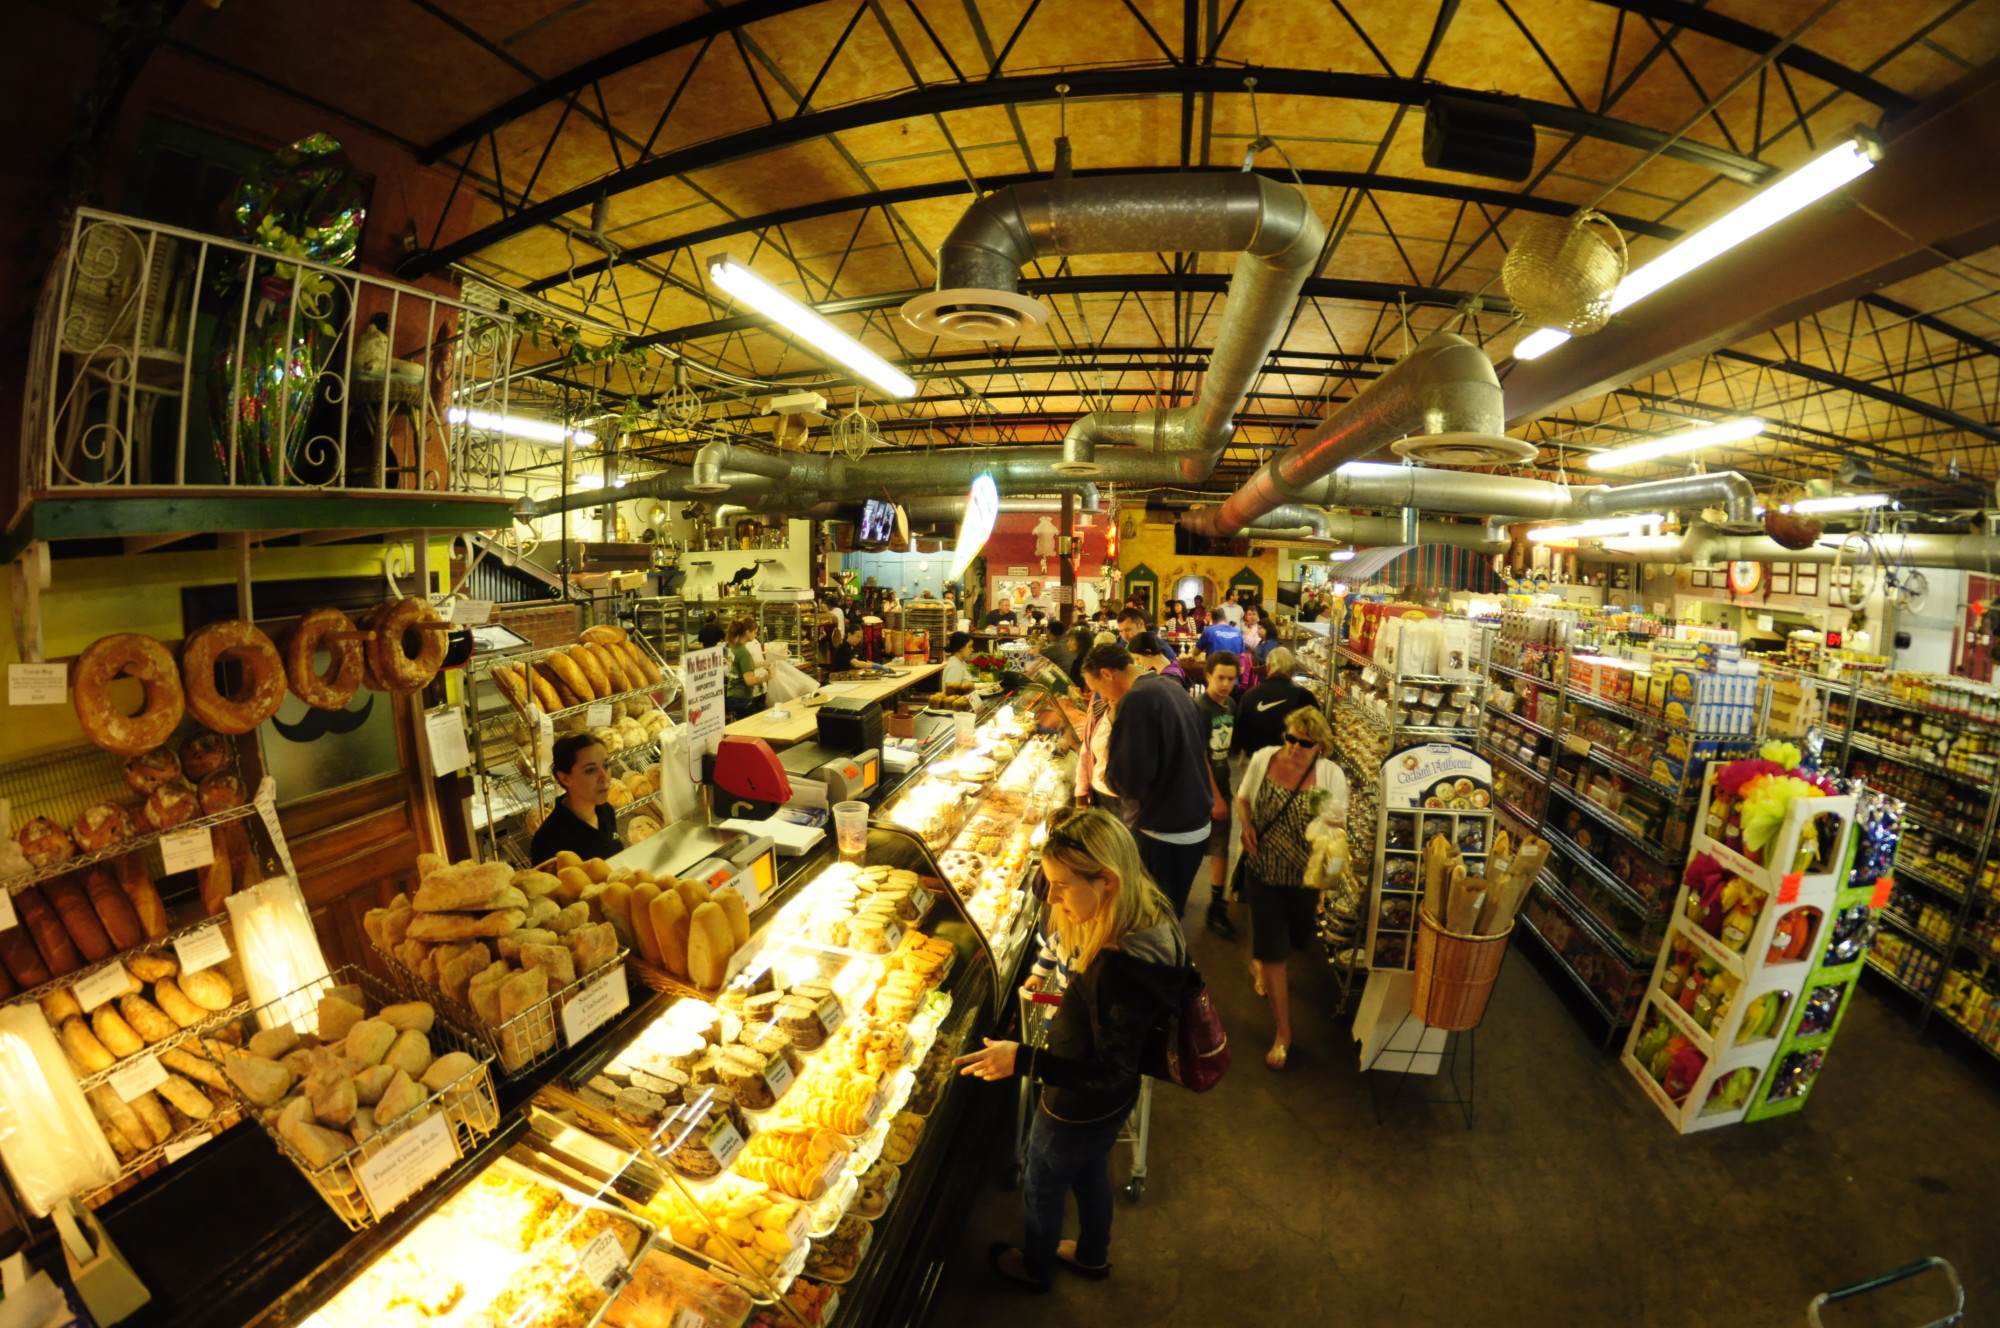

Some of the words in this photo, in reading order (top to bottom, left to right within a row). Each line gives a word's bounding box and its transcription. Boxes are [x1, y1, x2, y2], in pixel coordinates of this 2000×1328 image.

[687, 657, 695, 675] Who
[694, 672, 706, 682] GIANT
[688, 697, 699, 706] MILK
[699, 689, 723, 702] CHOCOLATE
[594, 1233, 615, 1256] PIZZA
